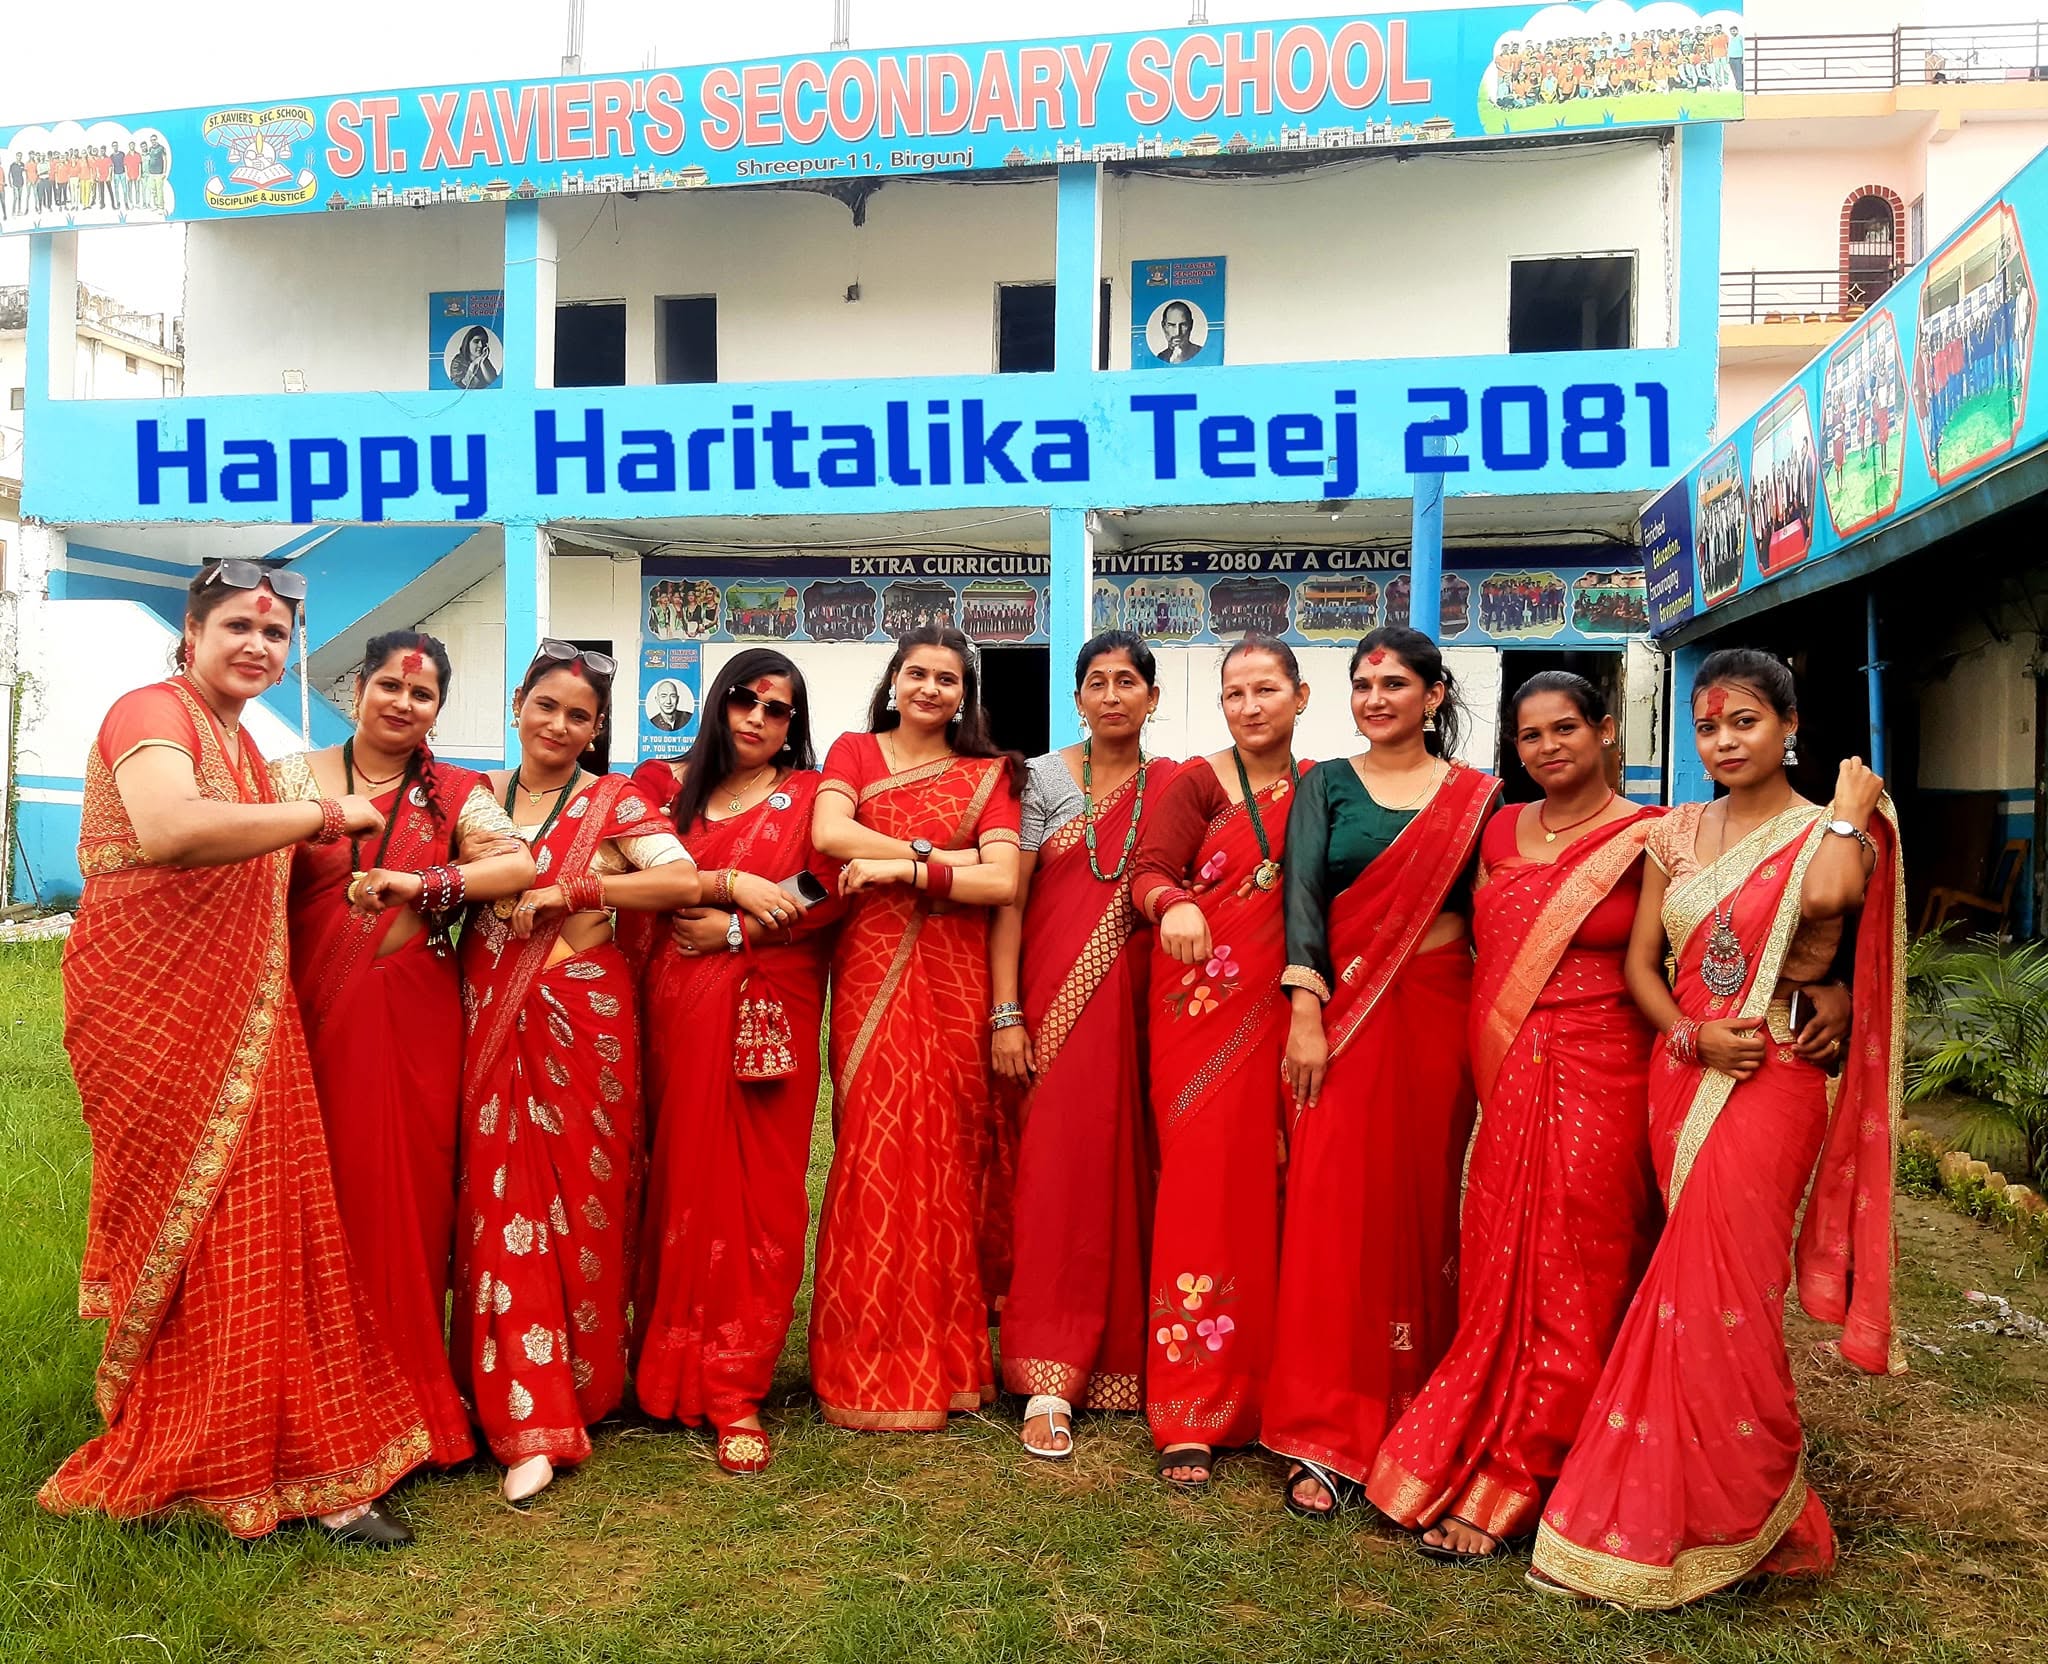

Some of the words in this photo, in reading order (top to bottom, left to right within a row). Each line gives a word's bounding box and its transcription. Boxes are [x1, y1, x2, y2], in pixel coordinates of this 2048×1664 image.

[326, 98, 407, 178] ST.
[418, 73, 686, 170] XAVIER'S
[700, 42, 1113, 151] SECONDARY
[1125, 20, 1432, 126] SCHOOL
[209, 117, 219, 128] ST.
[276, 108, 308, 121] SCHOOL
[736, 152, 882, 177] Shreepur-11,
[890, 147, 974, 170] Birgunj
[210, 194, 259, 206] DISCIPLINE
[260, 192, 267, 201] &
[269, 190, 306, 202] JUSTICE
[1644, 513, 1666, 548] Enriched
[850, 557, 916, 575] EXTRA
[1093, 554, 1184, 573] TIVITIES
[1207, 552, 1261, 571] 2080
[1268, 552, 1296, 570] AT
[1302, 551, 1320, 570] A
[642, 735, 649, 743] IF
[650, 735, 663, 743] YOU
[653, 744, 666, 752] YOU
